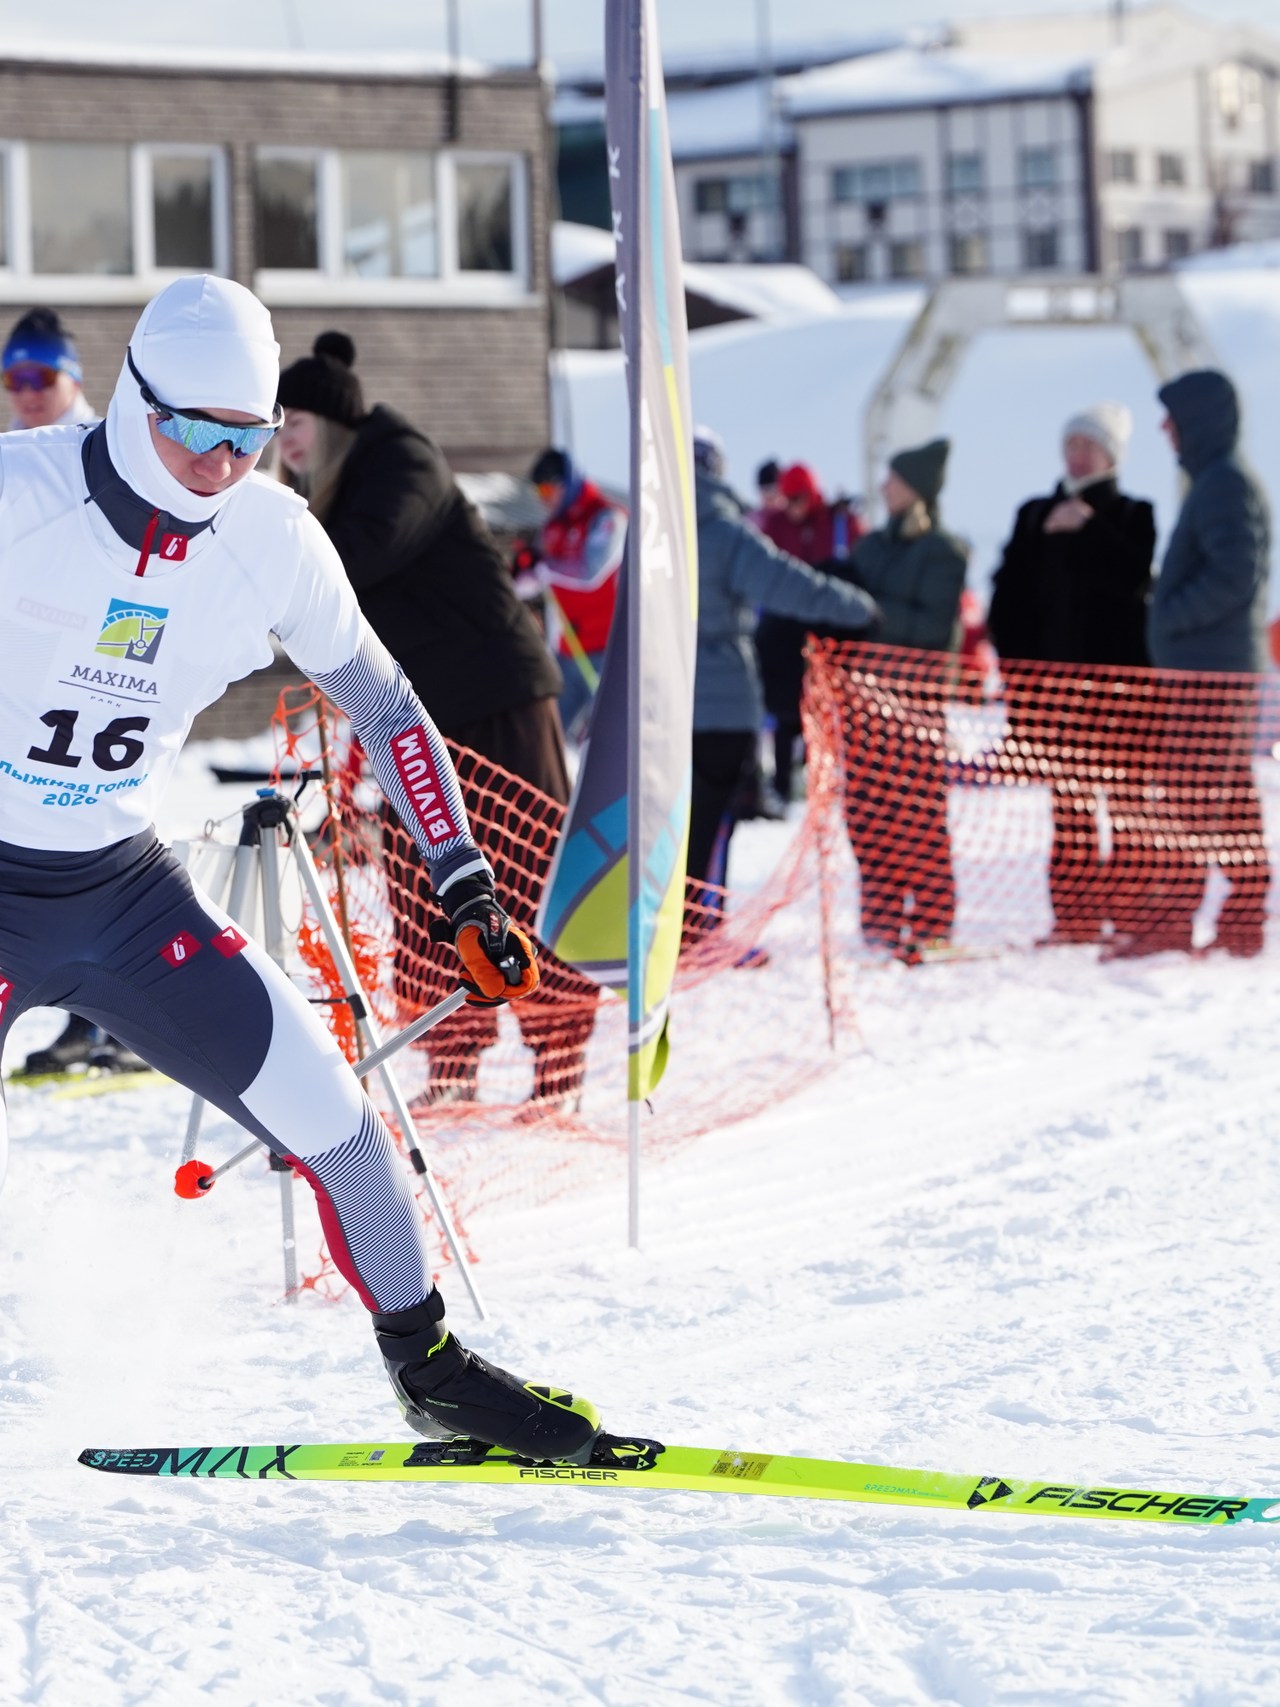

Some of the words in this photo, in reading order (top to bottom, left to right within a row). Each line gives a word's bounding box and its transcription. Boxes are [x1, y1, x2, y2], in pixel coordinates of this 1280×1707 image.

[70, 665, 157, 695] MAXIMA
[27, 709, 150, 772] 16
[397, 733, 450, 839] BIVIUM
[519, 1468, 618, 1481] FISCHER
[864, 1484, 917, 1495] SPEEDMAX
[1025, 1486, 1249, 1519] FISCHER
